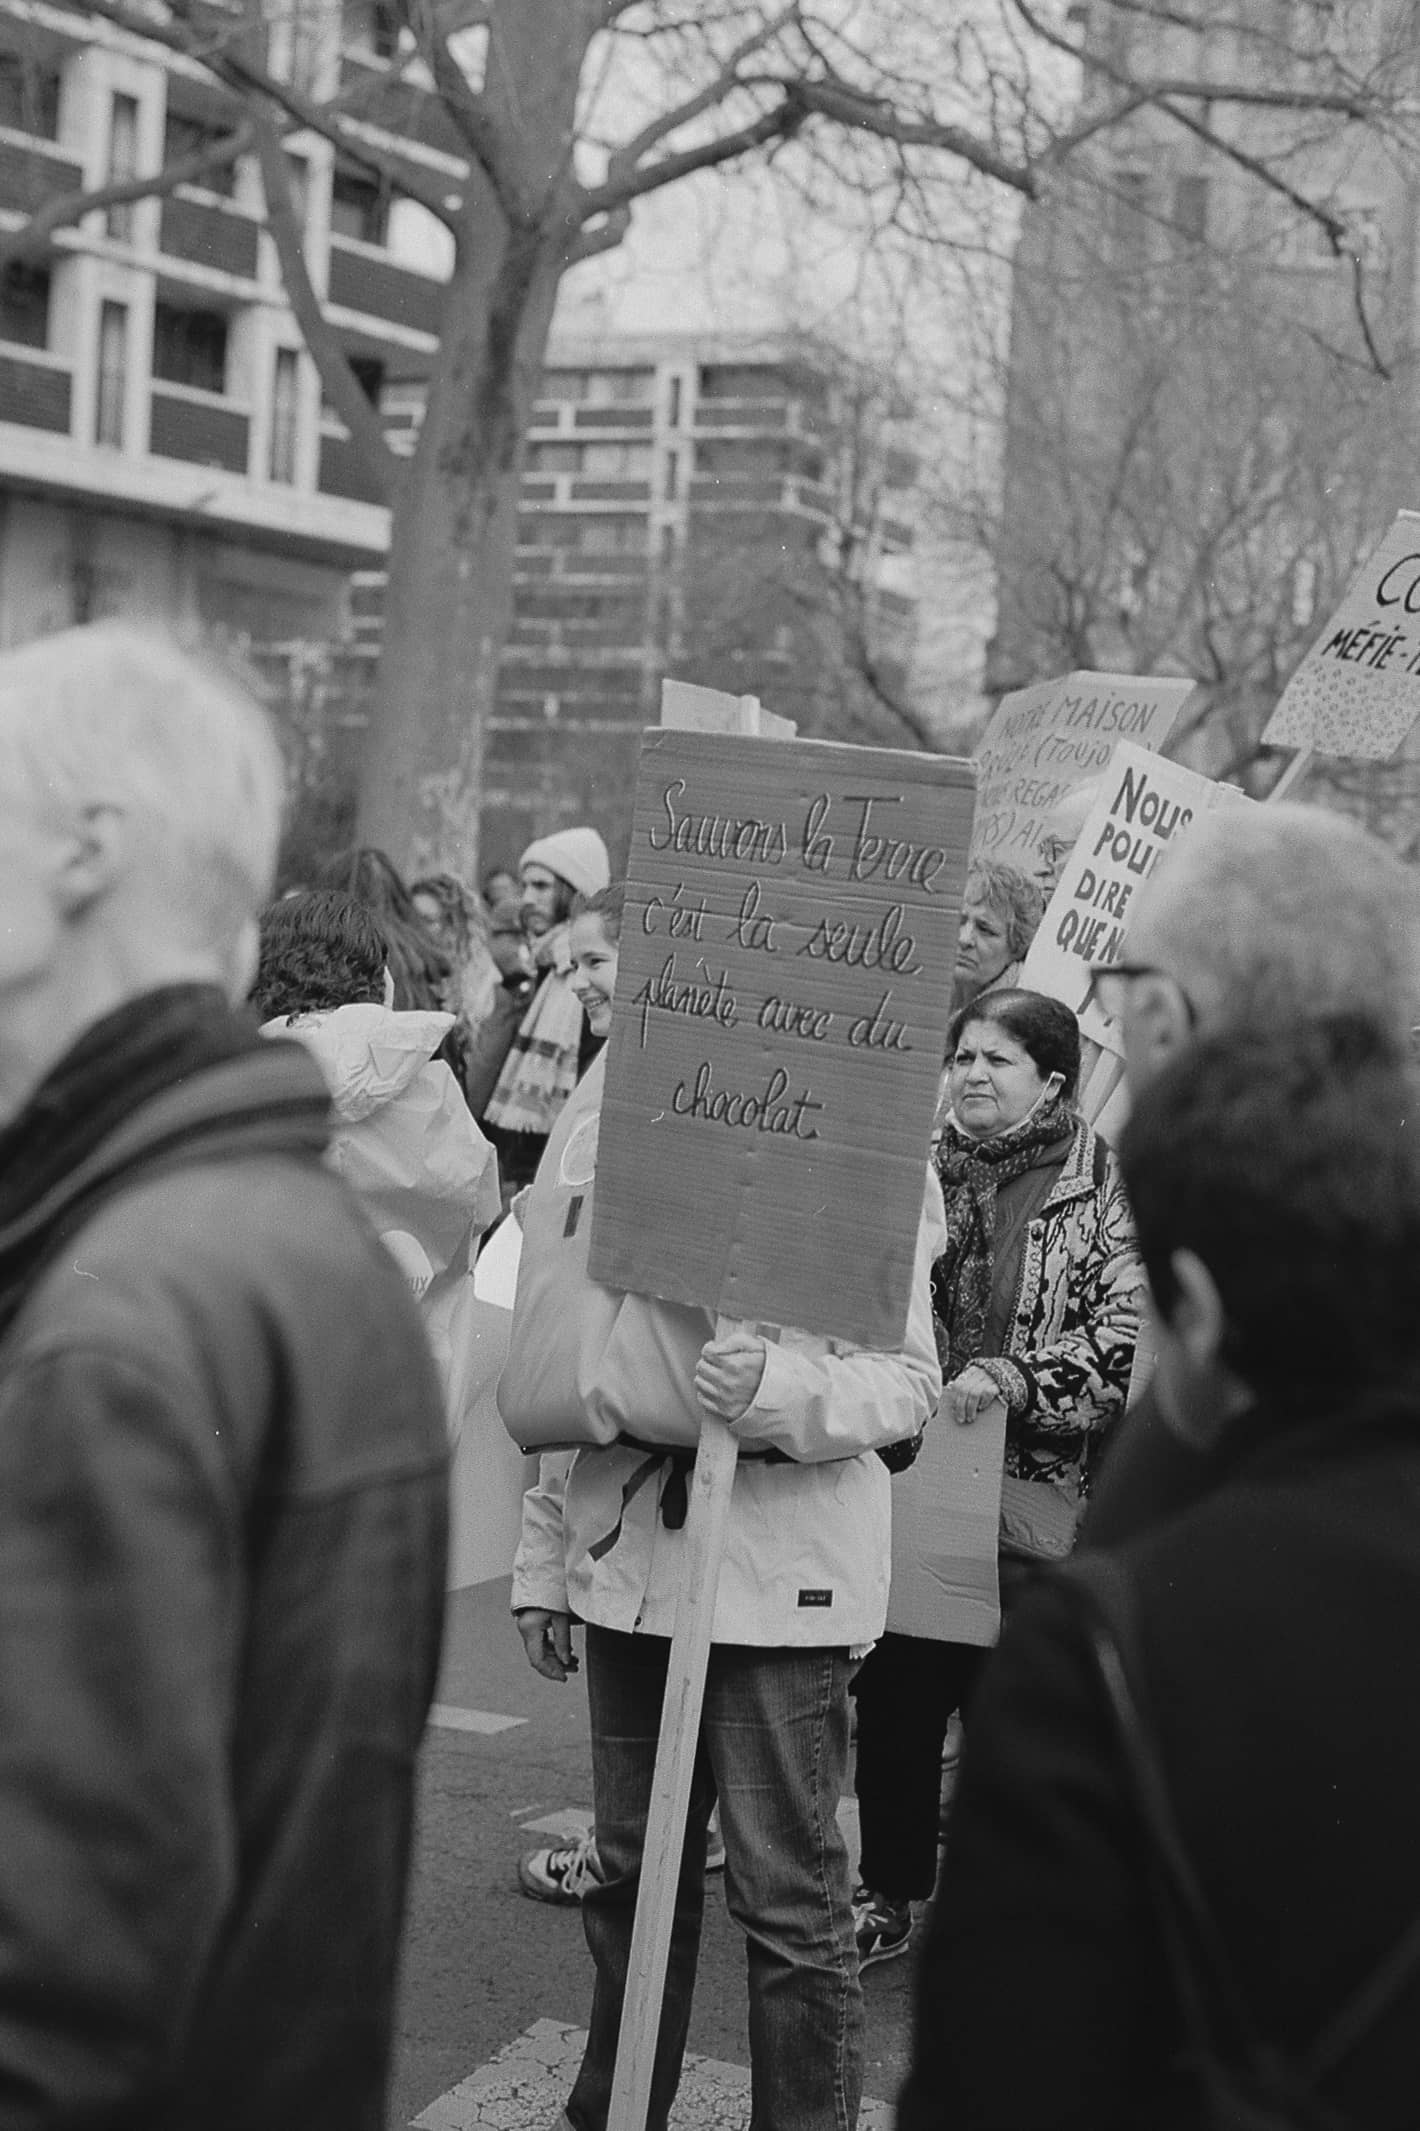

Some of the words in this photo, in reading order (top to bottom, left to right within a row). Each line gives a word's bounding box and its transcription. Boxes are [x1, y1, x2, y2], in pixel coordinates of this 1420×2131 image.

[1051, 691, 1157, 733] MAISON
[649, 778, 788, 864] Sauvons
[802, 792, 836, 872] la
[843, 795, 946, 895] Terre
[1073, 868, 1133, 920] DIRE
[642, 882, 711, 943] c'est
[726, 880, 781, 953] la
[796, 903, 923, 975] seule
[1056, 908, 1108, 962] QUE
[757, 995, 835, 1041] avec
[847, 989, 914, 1052] du
[672, 1061, 825, 1140] chocolat
